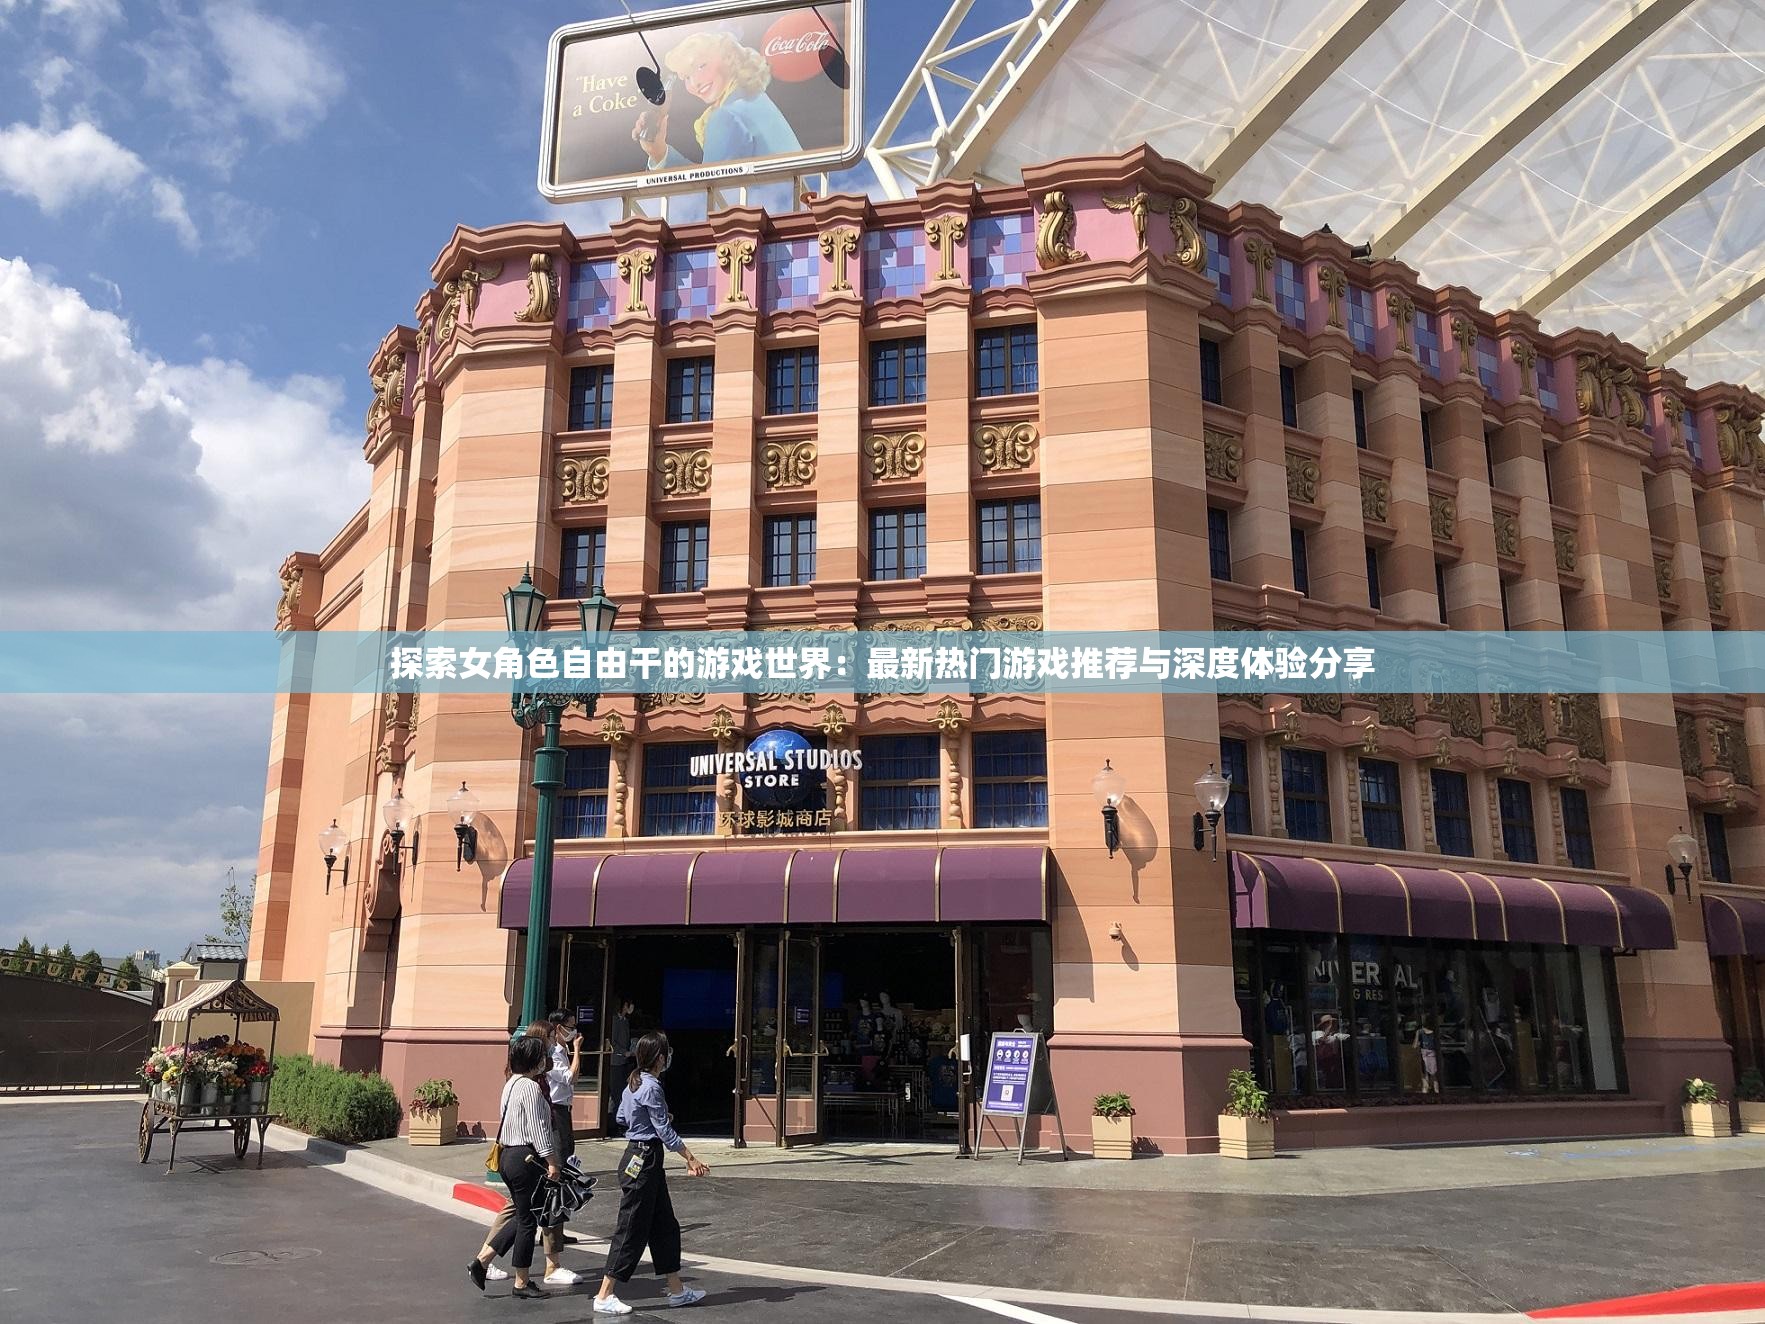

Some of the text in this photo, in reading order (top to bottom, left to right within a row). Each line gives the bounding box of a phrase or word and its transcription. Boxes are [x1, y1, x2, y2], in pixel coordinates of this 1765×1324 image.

[572, 104, 582, 117] a
[646, 166, 744, 185] UNIVERSAL PRODUCTIONS
[690, 749, 863, 777] UNIVERSAL STUDIOS
[744, 774, 800, 789] STORE
[719, 808, 833, 829] 环球影城商店
